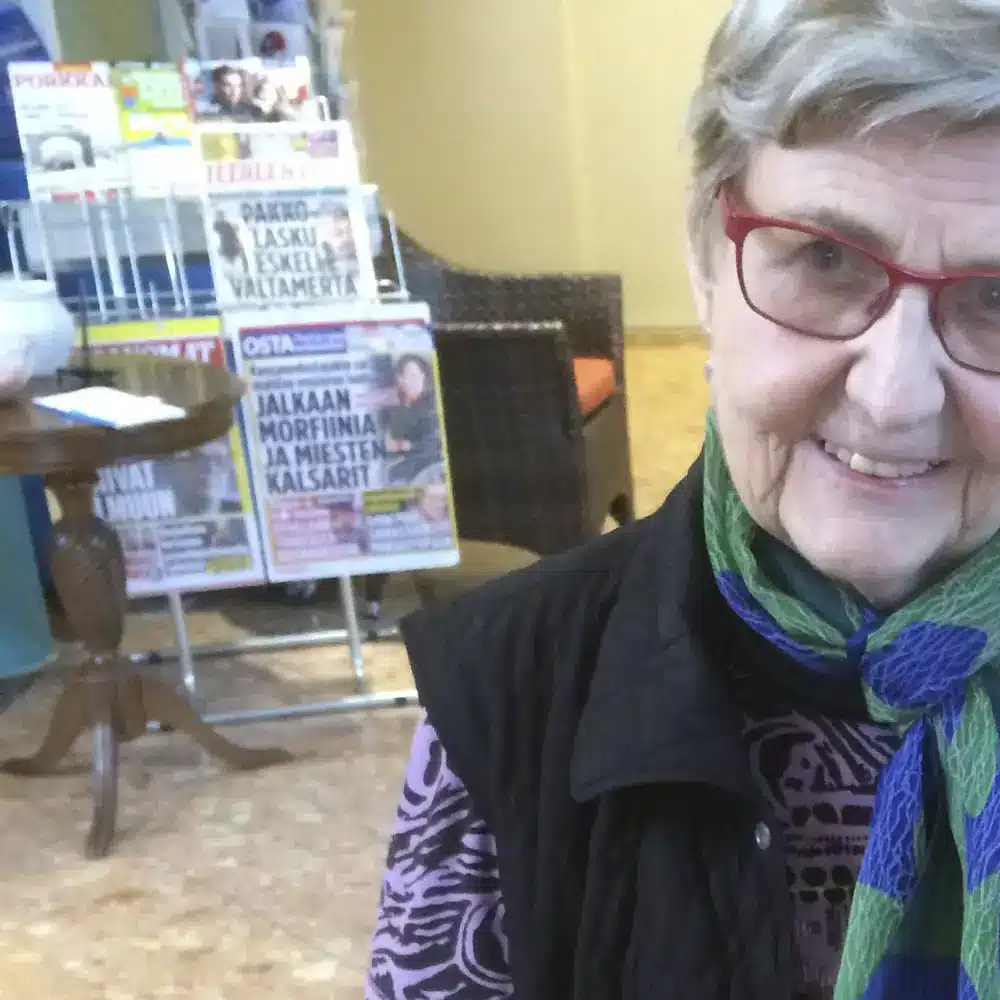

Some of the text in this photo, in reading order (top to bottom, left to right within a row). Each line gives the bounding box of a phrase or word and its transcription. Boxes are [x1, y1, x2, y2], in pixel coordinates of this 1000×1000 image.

[253, 227, 317, 249] LASKU
[257, 388, 351, 417] JALKAAN
[259, 413, 377, 443] MORFIINIA
[265, 439, 388, 467] JA MIESTEN
[265, 465, 370, 495] KALSARIT
